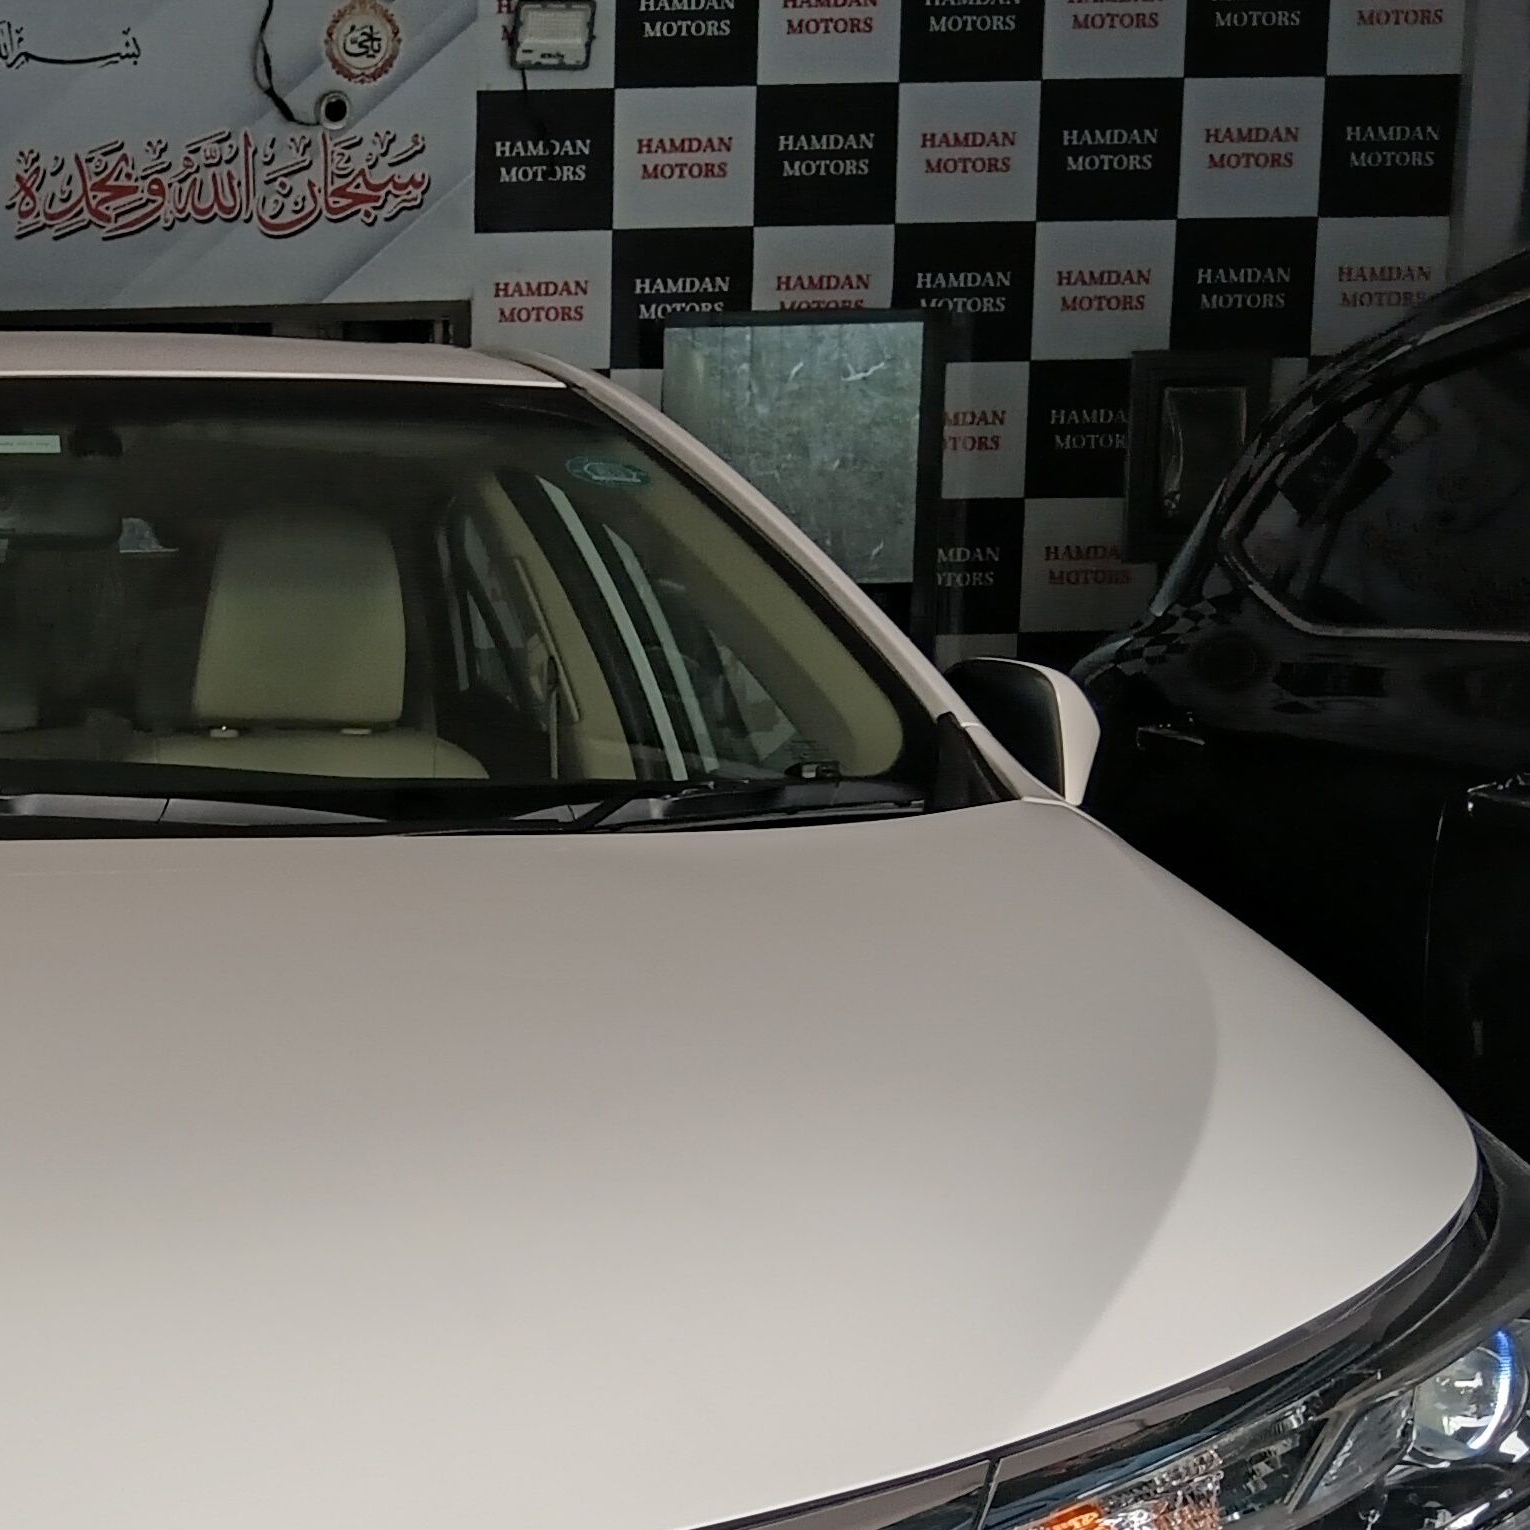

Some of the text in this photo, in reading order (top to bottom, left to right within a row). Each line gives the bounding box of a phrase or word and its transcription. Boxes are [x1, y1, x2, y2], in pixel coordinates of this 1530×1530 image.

[786, 16, 873, 35] MOTORS
[929, 15, 1016, 33] MOTORS
[1072, 12, 1159, 30] MOTORS
[1215, 10, 1301, 28] MOTORS
[1357, 8, 1444, 26] MOTORS
[643, 19, 731, 38] MOTORS
[778, 133, 875, 152] HAMDAN
[920, 131, 1016, 149] HAMDAN
[1062, 128, 1158, 146] HAMDAN
[1204, 126, 1299, 144] HAMDAN
[1346, 125, 1440, 142] HAMDAN
[637, 136, 733, 155] HAMDAN
[782, 158, 869, 177] MOTORS
[925, 156, 1011, 174] MOTORS
[1066, 153, 1152, 171] MOTORS
[1208, 151, 1294, 169] MOTORS
[1349, 150, 1435, 168] MOTORS
[641, 161, 728, 180] MOTORS
[916, 271, 1012, 289] HAMDAN
[1057, 269, 1152, 287] HAMDAN
[1197, 267, 1291, 285] HAMDAN
[1337, 265, 1432, 282] HAMDAN
[493, 280, 589, 298] HAMDAN
[634, 276, 730, 295] HAMDAN
[776, 274, 871, 292] HAMDAN
[1060, 294, 1146, 312] MOTORS
[1200, 292, 1286, 310] MOTORS
[498, 305, 584, 323] MOTORS
[943, 410, 1006, 427] MDAN
[1049, 408, 1128, 425] HAMDA
[1053, 433, 1127, 450] MOTOR
[936, 546, 1000, 563] MDAN
[1044, 545, 1120, 561] HAMDA
